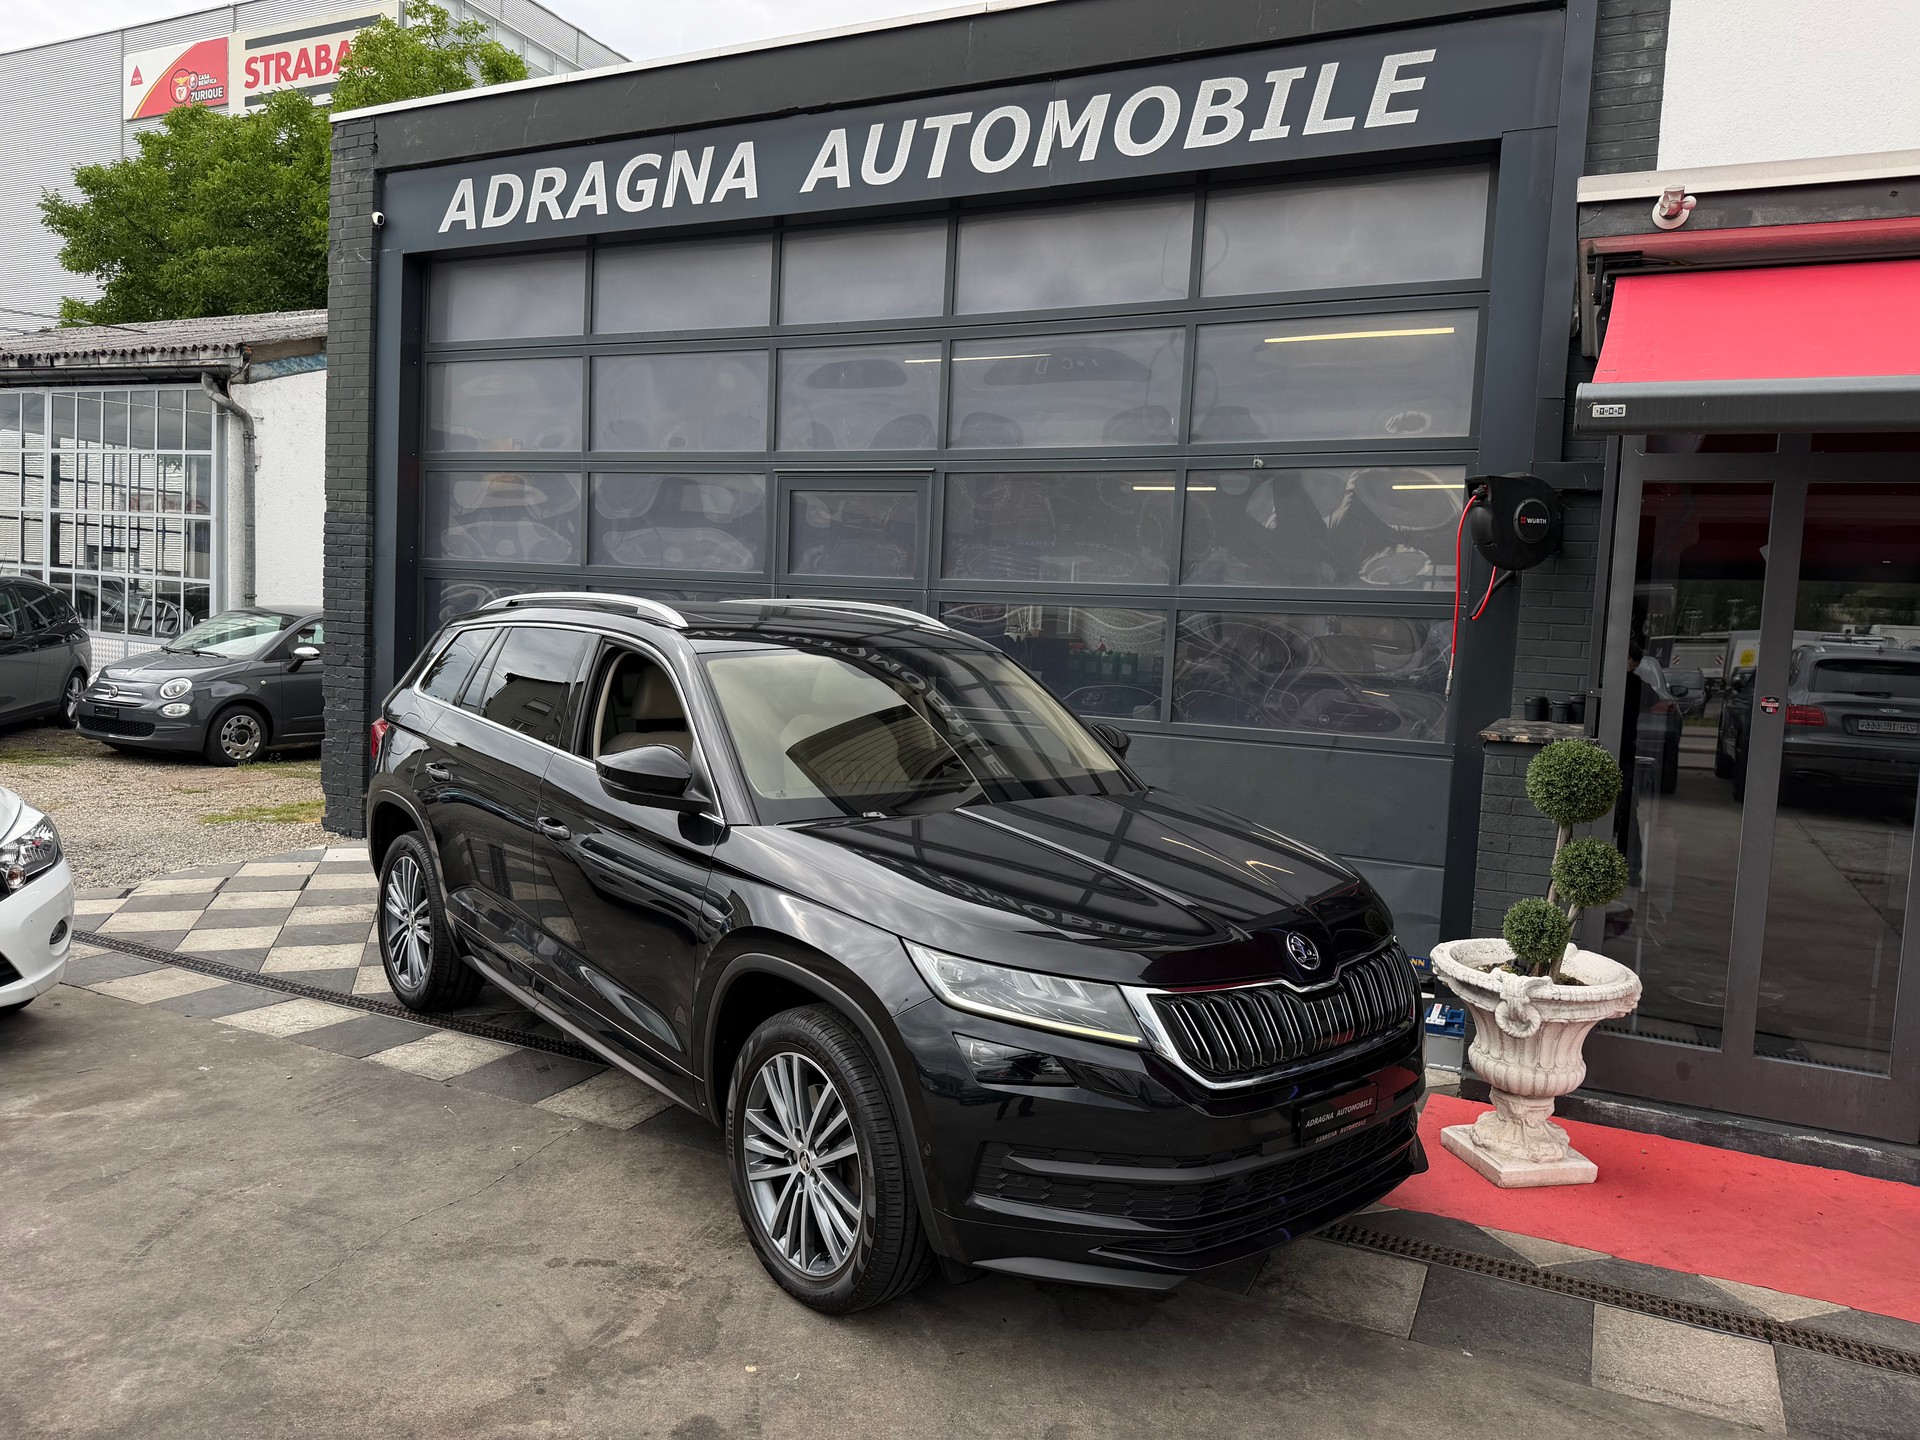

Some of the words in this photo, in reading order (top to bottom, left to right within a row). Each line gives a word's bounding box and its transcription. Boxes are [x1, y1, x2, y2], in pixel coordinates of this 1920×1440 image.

[244, 39, 366, 89] STRABA
[190, 87, 224, 102] ZURIQUE
[198, 78, 217, 86] BENFICA
[438, 141, 759, 233] ADRAGNA
[799, 48, 1437, 193] AUTOMOBILE
[1305, 1111, 1334, 1128] ADRAGNA
[1336, 1097, 1373, 1116] AUTOMOBILE
